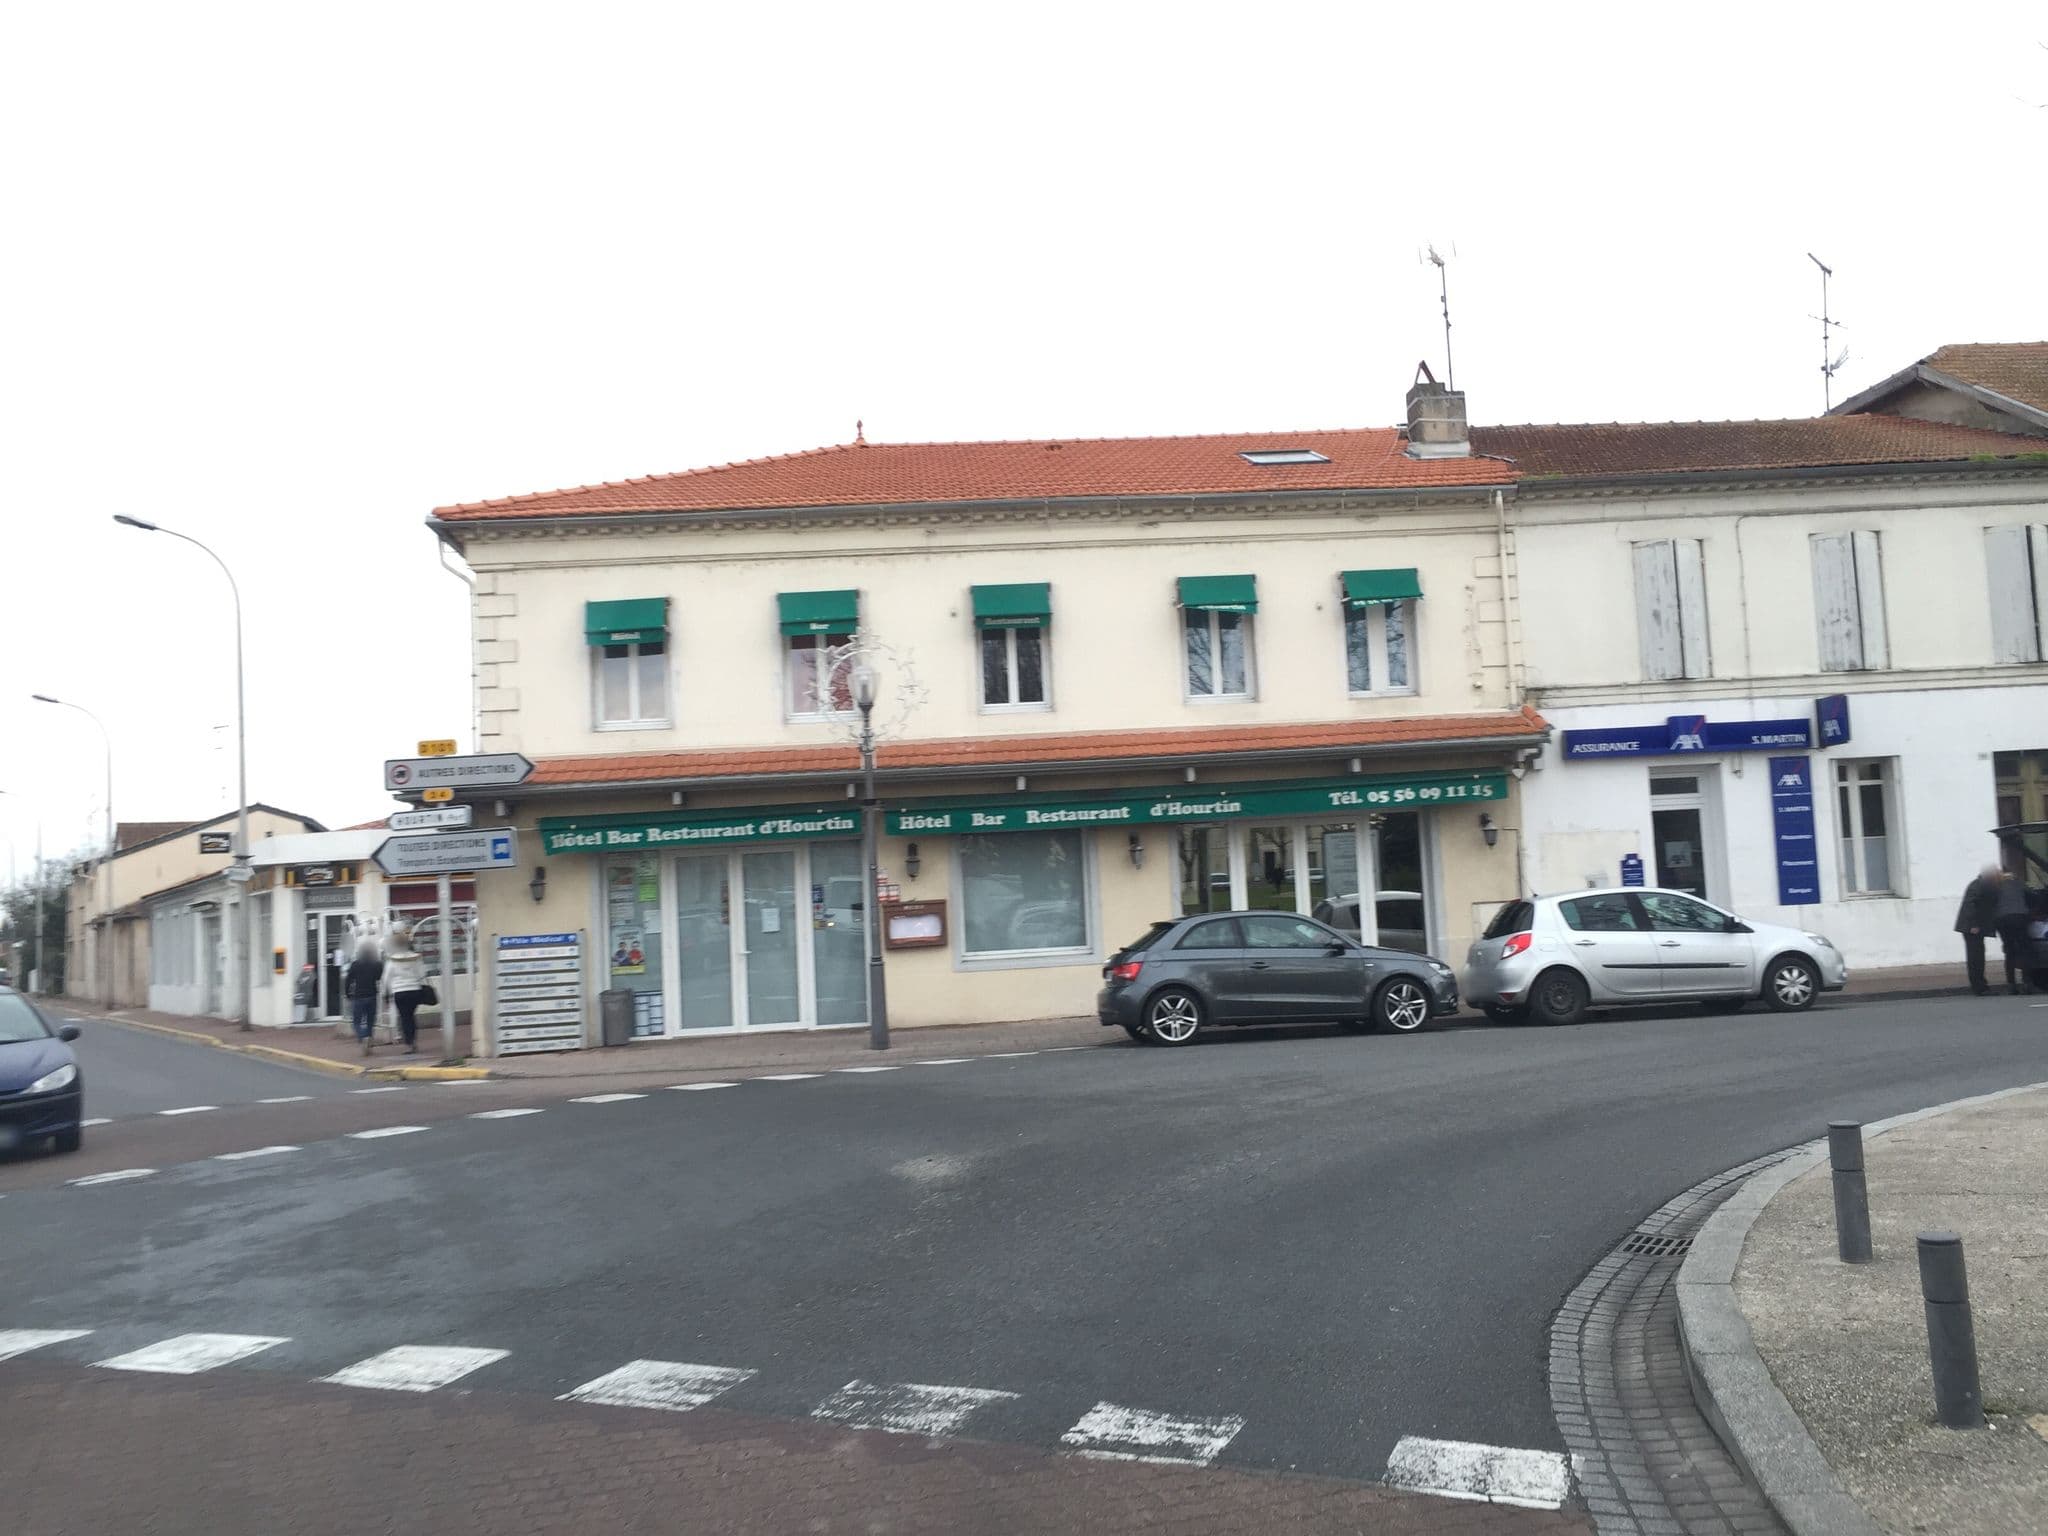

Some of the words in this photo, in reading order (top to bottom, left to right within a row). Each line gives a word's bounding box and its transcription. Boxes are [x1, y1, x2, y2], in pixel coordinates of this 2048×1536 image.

[1571, 741, 1641, 753] ASSURANCE
[1669, 734, 1705, 750] AXA
[419, 768, 455, 778] AUTRES
[458, 764, 517, 776] DIRECTIONS
[1328, 790, 1363, 806] Tél.
[1366, 790, 1390, 803] 05
[1393, 788, 1416, 801] 56
[1419, 787, 1442, 800] 09
[1446, 785, 1467, 797] 11
[1471, 784, 1494, 797] 15
[396, 813, 442, 826] HOURTIN
[900, 814, 951, 830] Hôtel
[971, 813, 1006, 826] Bar
[1026, 806, 1130, 824] Restaurant
[1150, 800, 1242, 816] d'Hourtin
[551, 831, 602, 849] Hôtel
[606, 830, 643, 844] Bar
[646, 823, 756, 841] Restaurant
[759, 816, 855, 834] d'Hourtin
[398, 842, 430, 852] TOUTES
[433, 838, 486, 850] DIRECTIONS
